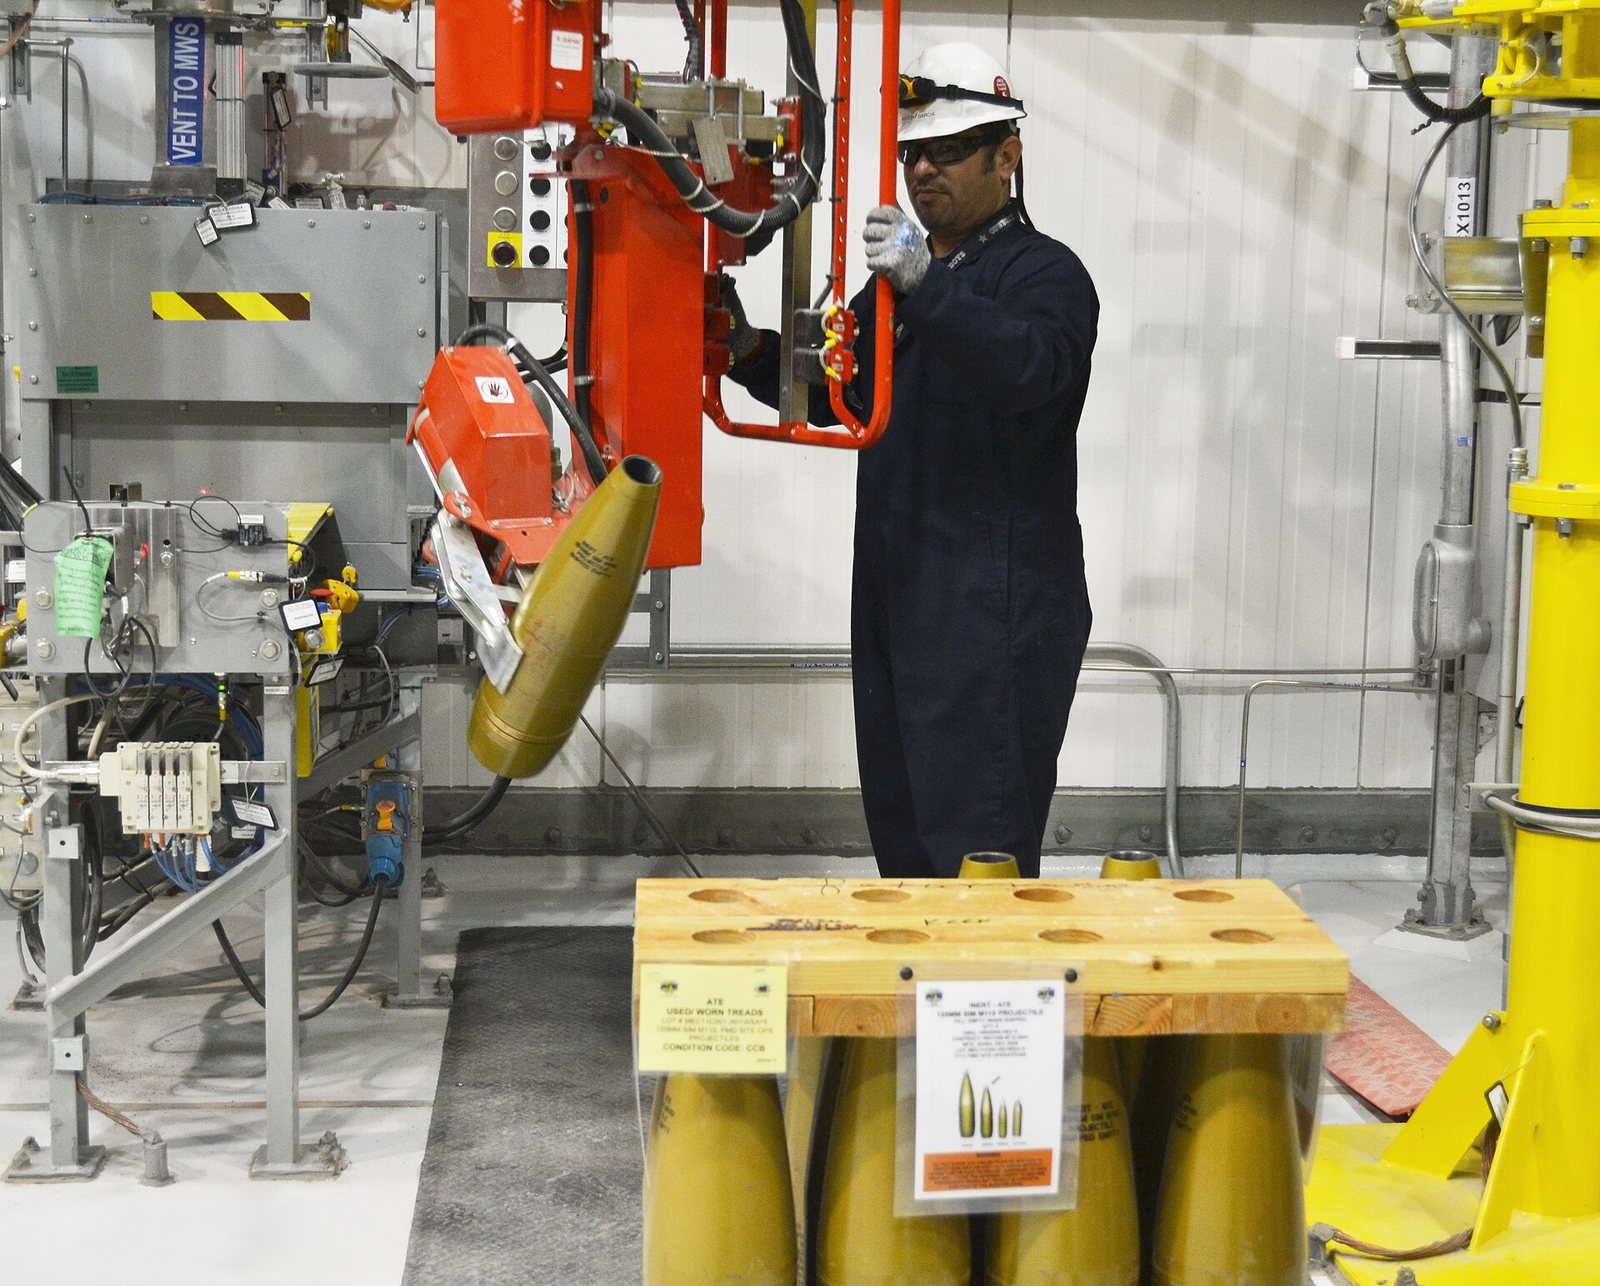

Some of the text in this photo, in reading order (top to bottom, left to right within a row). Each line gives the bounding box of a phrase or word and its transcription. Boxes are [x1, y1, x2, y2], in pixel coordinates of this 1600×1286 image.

[172, 23, 200, 160] VENT TO MWS
[1457, 182, 1471, 237] X1013
[707, 998, 724, 1006] ATE
[667, 1008, 764, 1017] USED/ WORN TREADS
[998, 1008, 1044, 1016] PROJECTILE
[662, 1043, 713, 1051] CONDITION
